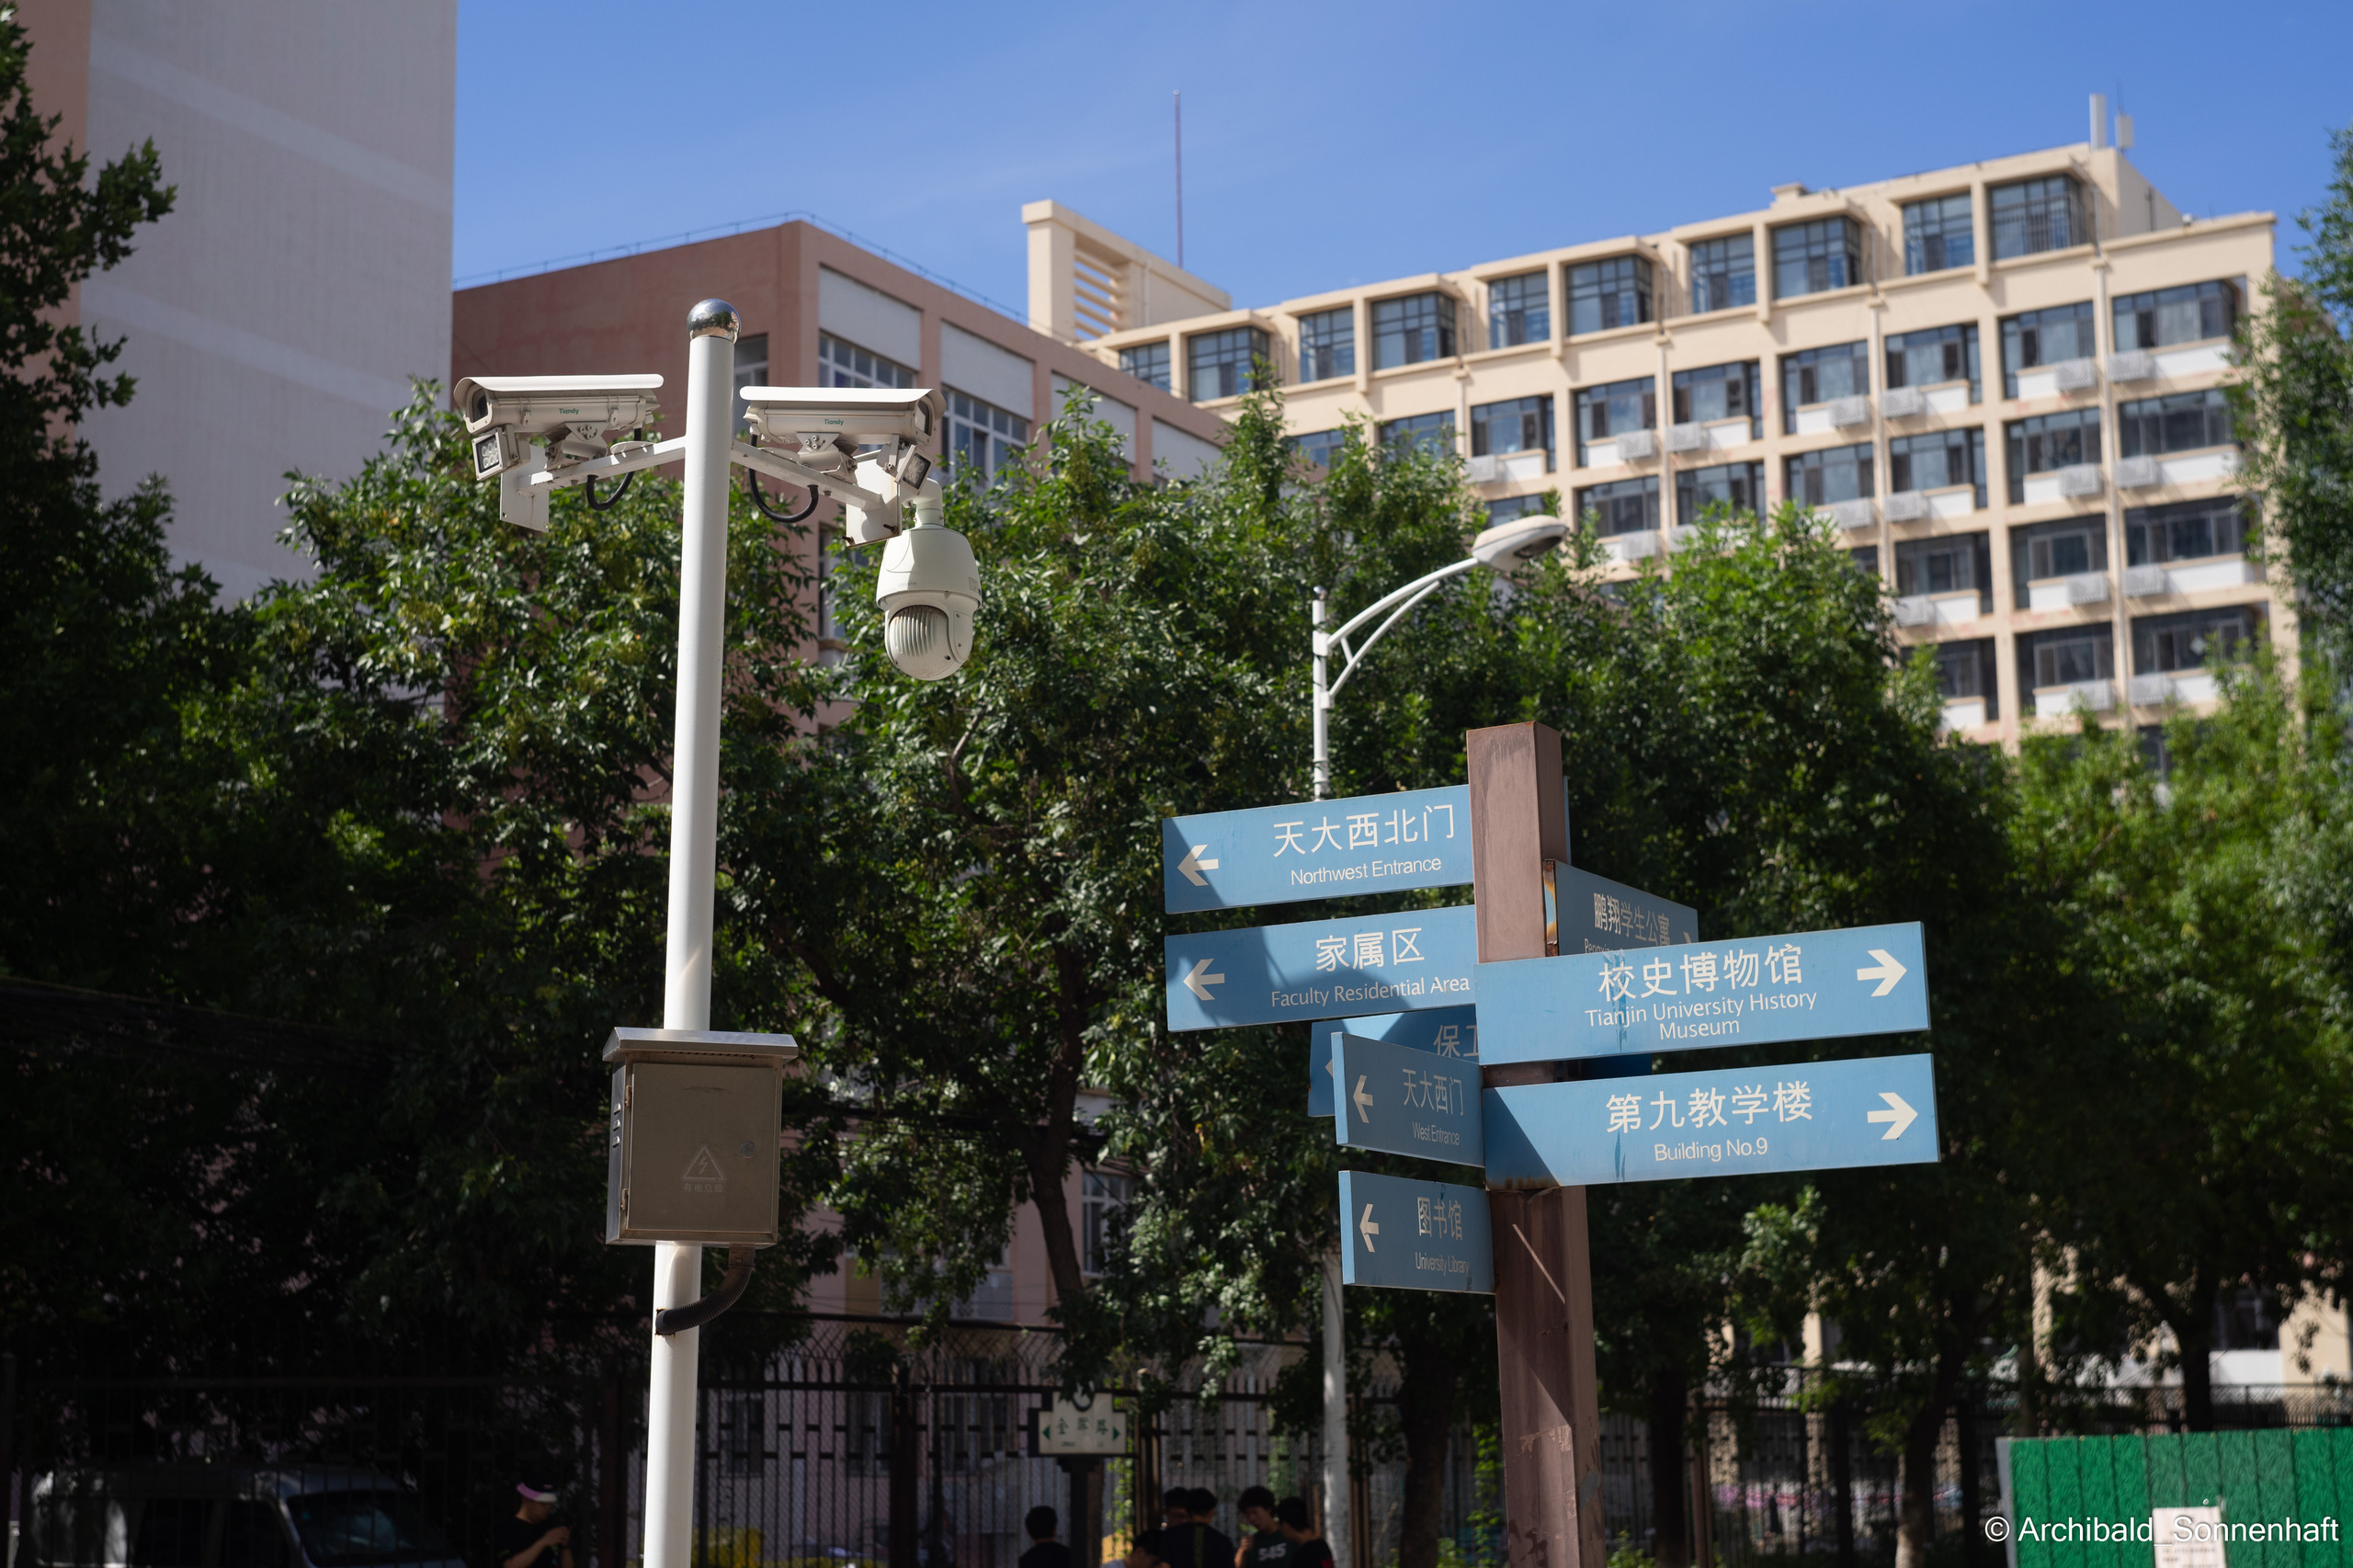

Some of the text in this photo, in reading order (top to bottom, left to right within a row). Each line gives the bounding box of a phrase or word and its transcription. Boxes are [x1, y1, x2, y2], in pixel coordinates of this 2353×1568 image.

[824, 418, 845, 426] Tiandy
[1273, 804, 1454, 858] 天大西北门
[1290, 858, 1442, 886] Northwest Entrance
[1593, 892, 1671, 947] 鹏翔学生公寓
[1315, 927, 1425, 972] 家属区
[1597, 942, 1803, 1002] 校史博物馆
[1271, 976, 1471, 1007] Faculty Residential Area
[1586, 1006, 1647, 1028] Tianjin
[1653, 995, 1745, 1021] University
[1659, 1018, 1741, 1040] Museum
[1402, 1068, 1464, 1117] 天大西门
[1605, 1080, 1813, 1134] 第九教学楼
[1412, 1121, 1460, 1146] West Entrance
[1654, 1137, 1768, 1163] Building No.9
[683, 1182, 724, 1194] 有电危险
[1416, 1196, 1463, 1241] 图书馆
[1415, 1251, 1469, 1278] University Library
